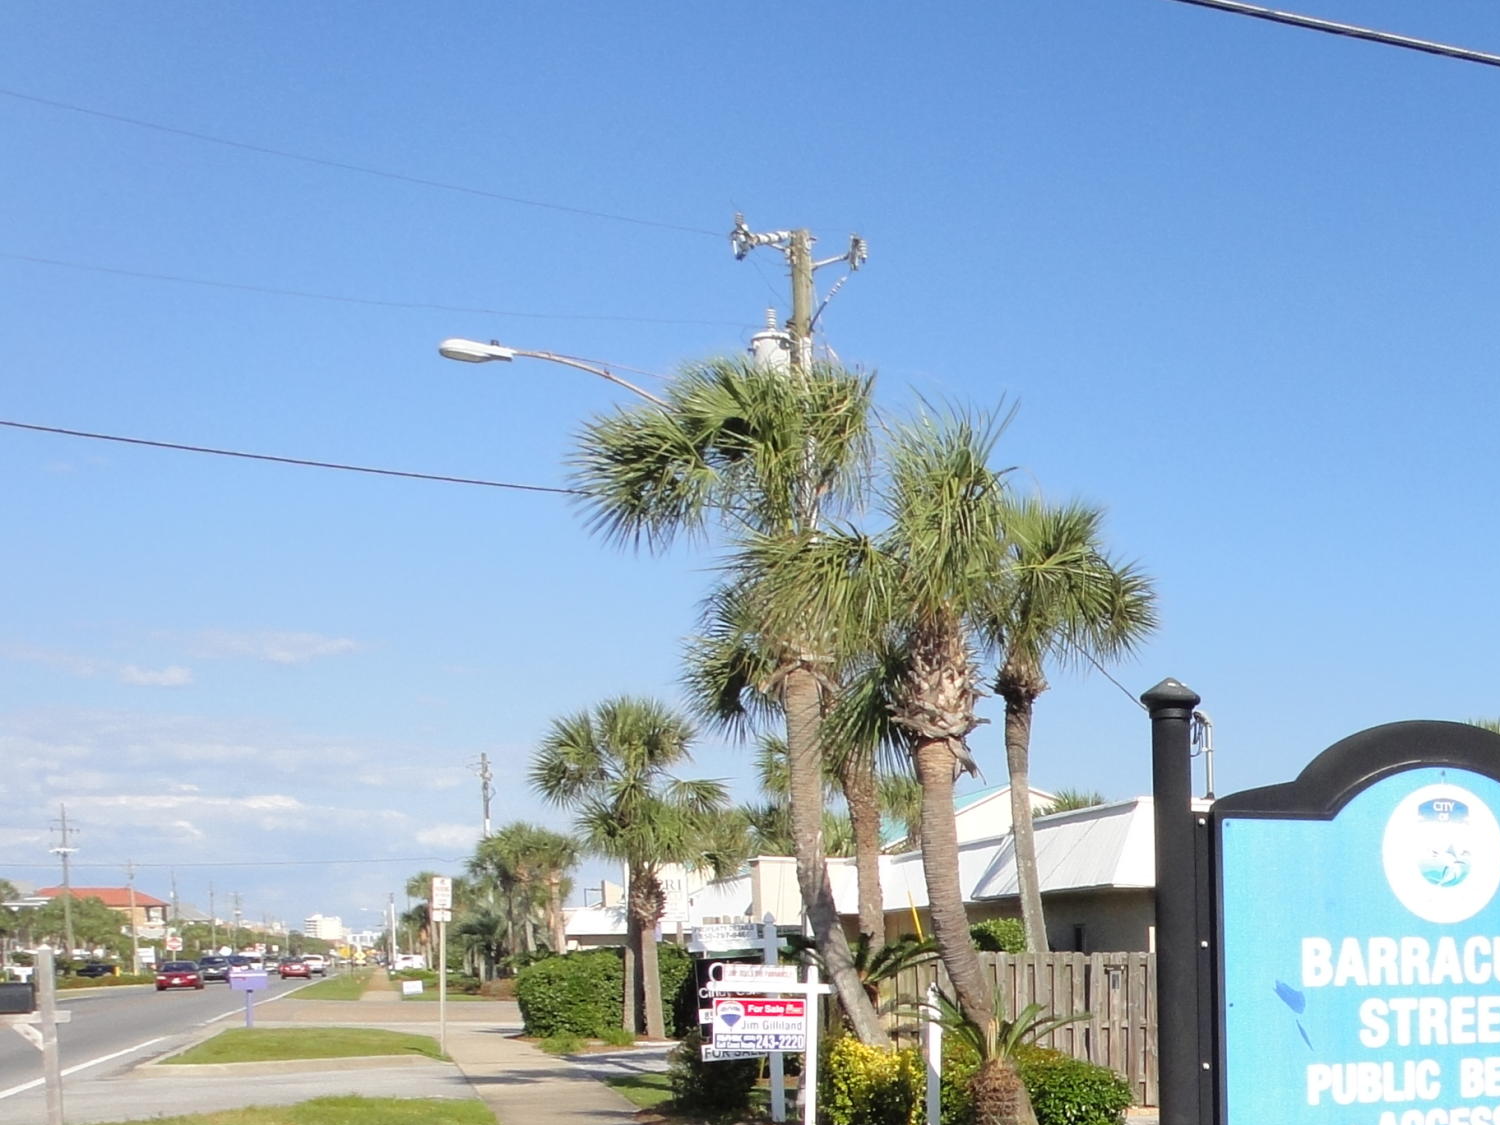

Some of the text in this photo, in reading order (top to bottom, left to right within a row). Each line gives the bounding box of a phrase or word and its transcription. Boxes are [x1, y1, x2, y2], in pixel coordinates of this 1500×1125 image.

[1433, 801, 1455, 812] CITY
[748, 1004, 763, 1013] For
[765, 1004, 784, 1013] Sale
[741, 1020, 802, 1031] Jim Gilliland
[756, 1034, 804, 1049] 243-2220
[704, 1047, 729, 1059] FOR
[1307, 1059, 1441, 1105] PUBLIC
